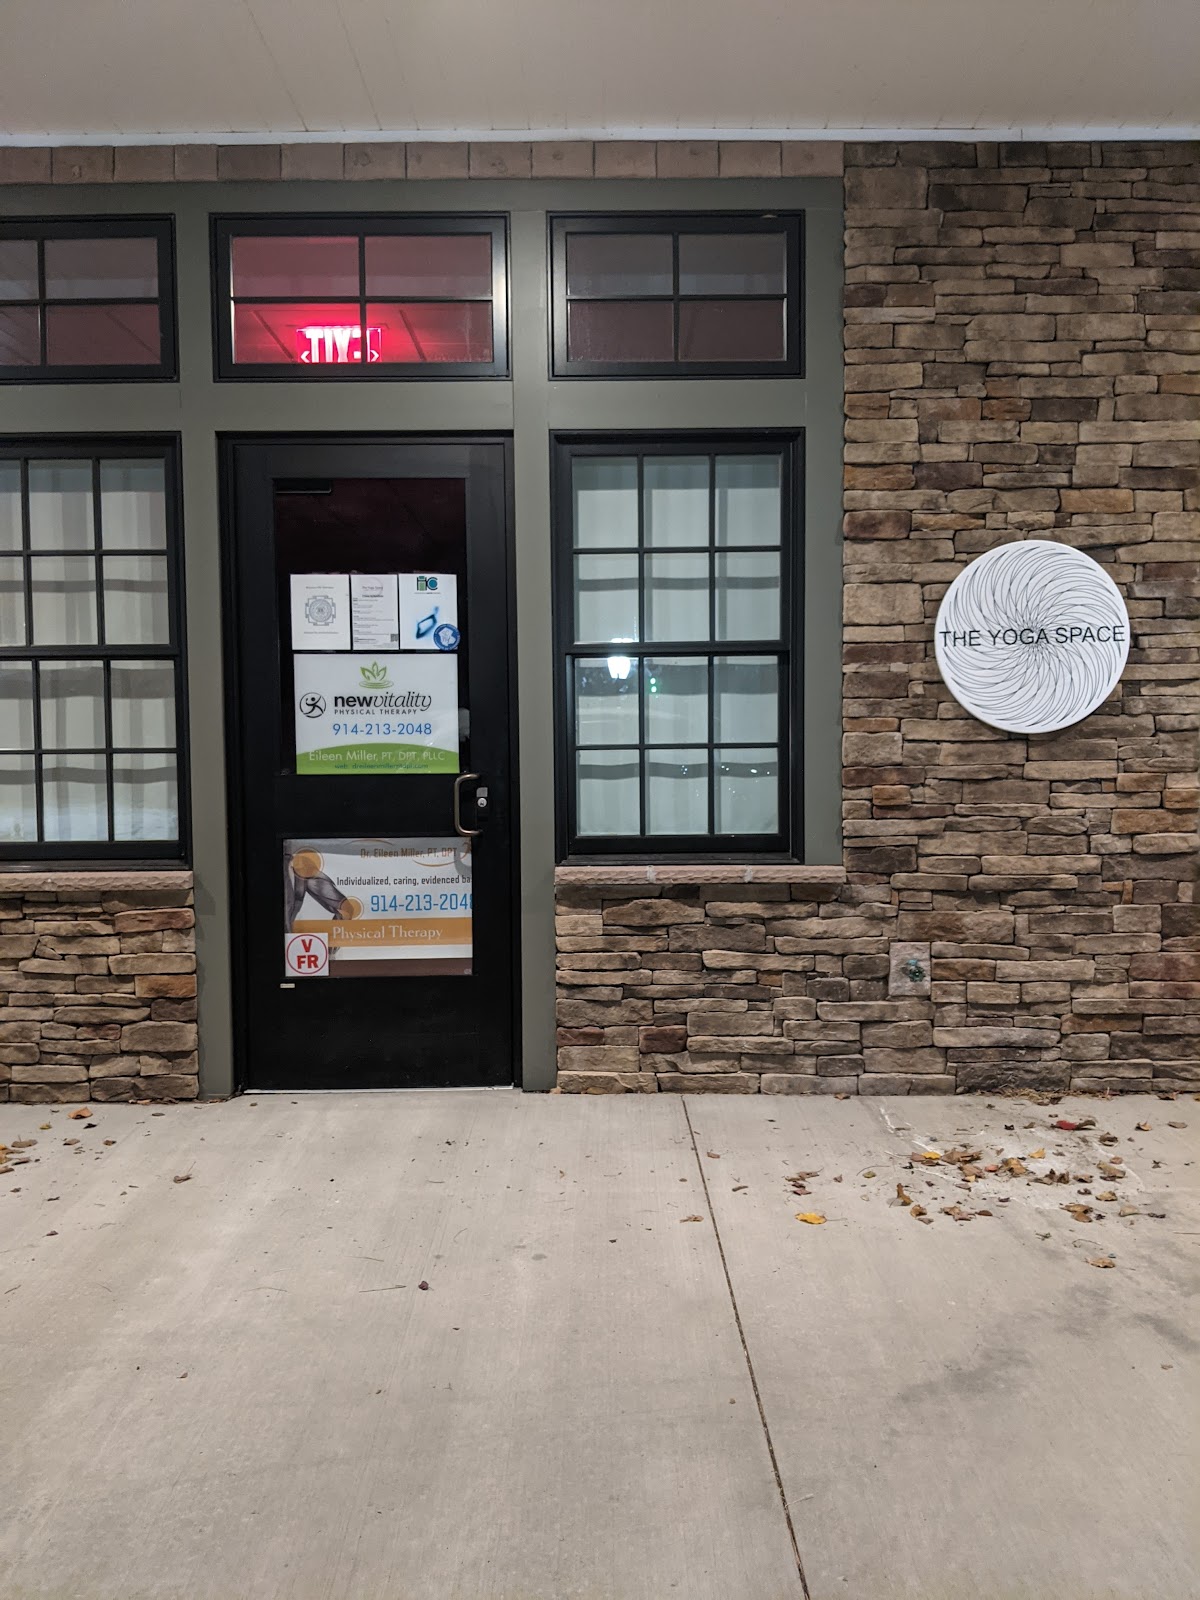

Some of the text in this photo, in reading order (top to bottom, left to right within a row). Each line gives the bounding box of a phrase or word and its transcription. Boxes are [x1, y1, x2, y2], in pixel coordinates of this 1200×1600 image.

[939, 625, 1126, 648] THE YOGA SPACE
[332, 723, 432, 735] 914-213-2048
[309, 751, 342, 761] Eileen
[346, 751, 378, 762] Miller,
[423, 752, 445, 761] PLLC
[360, 848, 372, 859] Dr.
[373, 848, 398, 858] Eileen
[400, 847, 425, 858] Miller,
[441, 847, 458, 858] DPT
[336, 876, 391, 887] Individualized,
[393, 876, 419, 887] caring,
[421, 875, 460, 885] evidenced
[332, 925, 443, 940] Physical Therapy
[300, 939, 313, 953] V
[296, 954, 319, 970] FR
